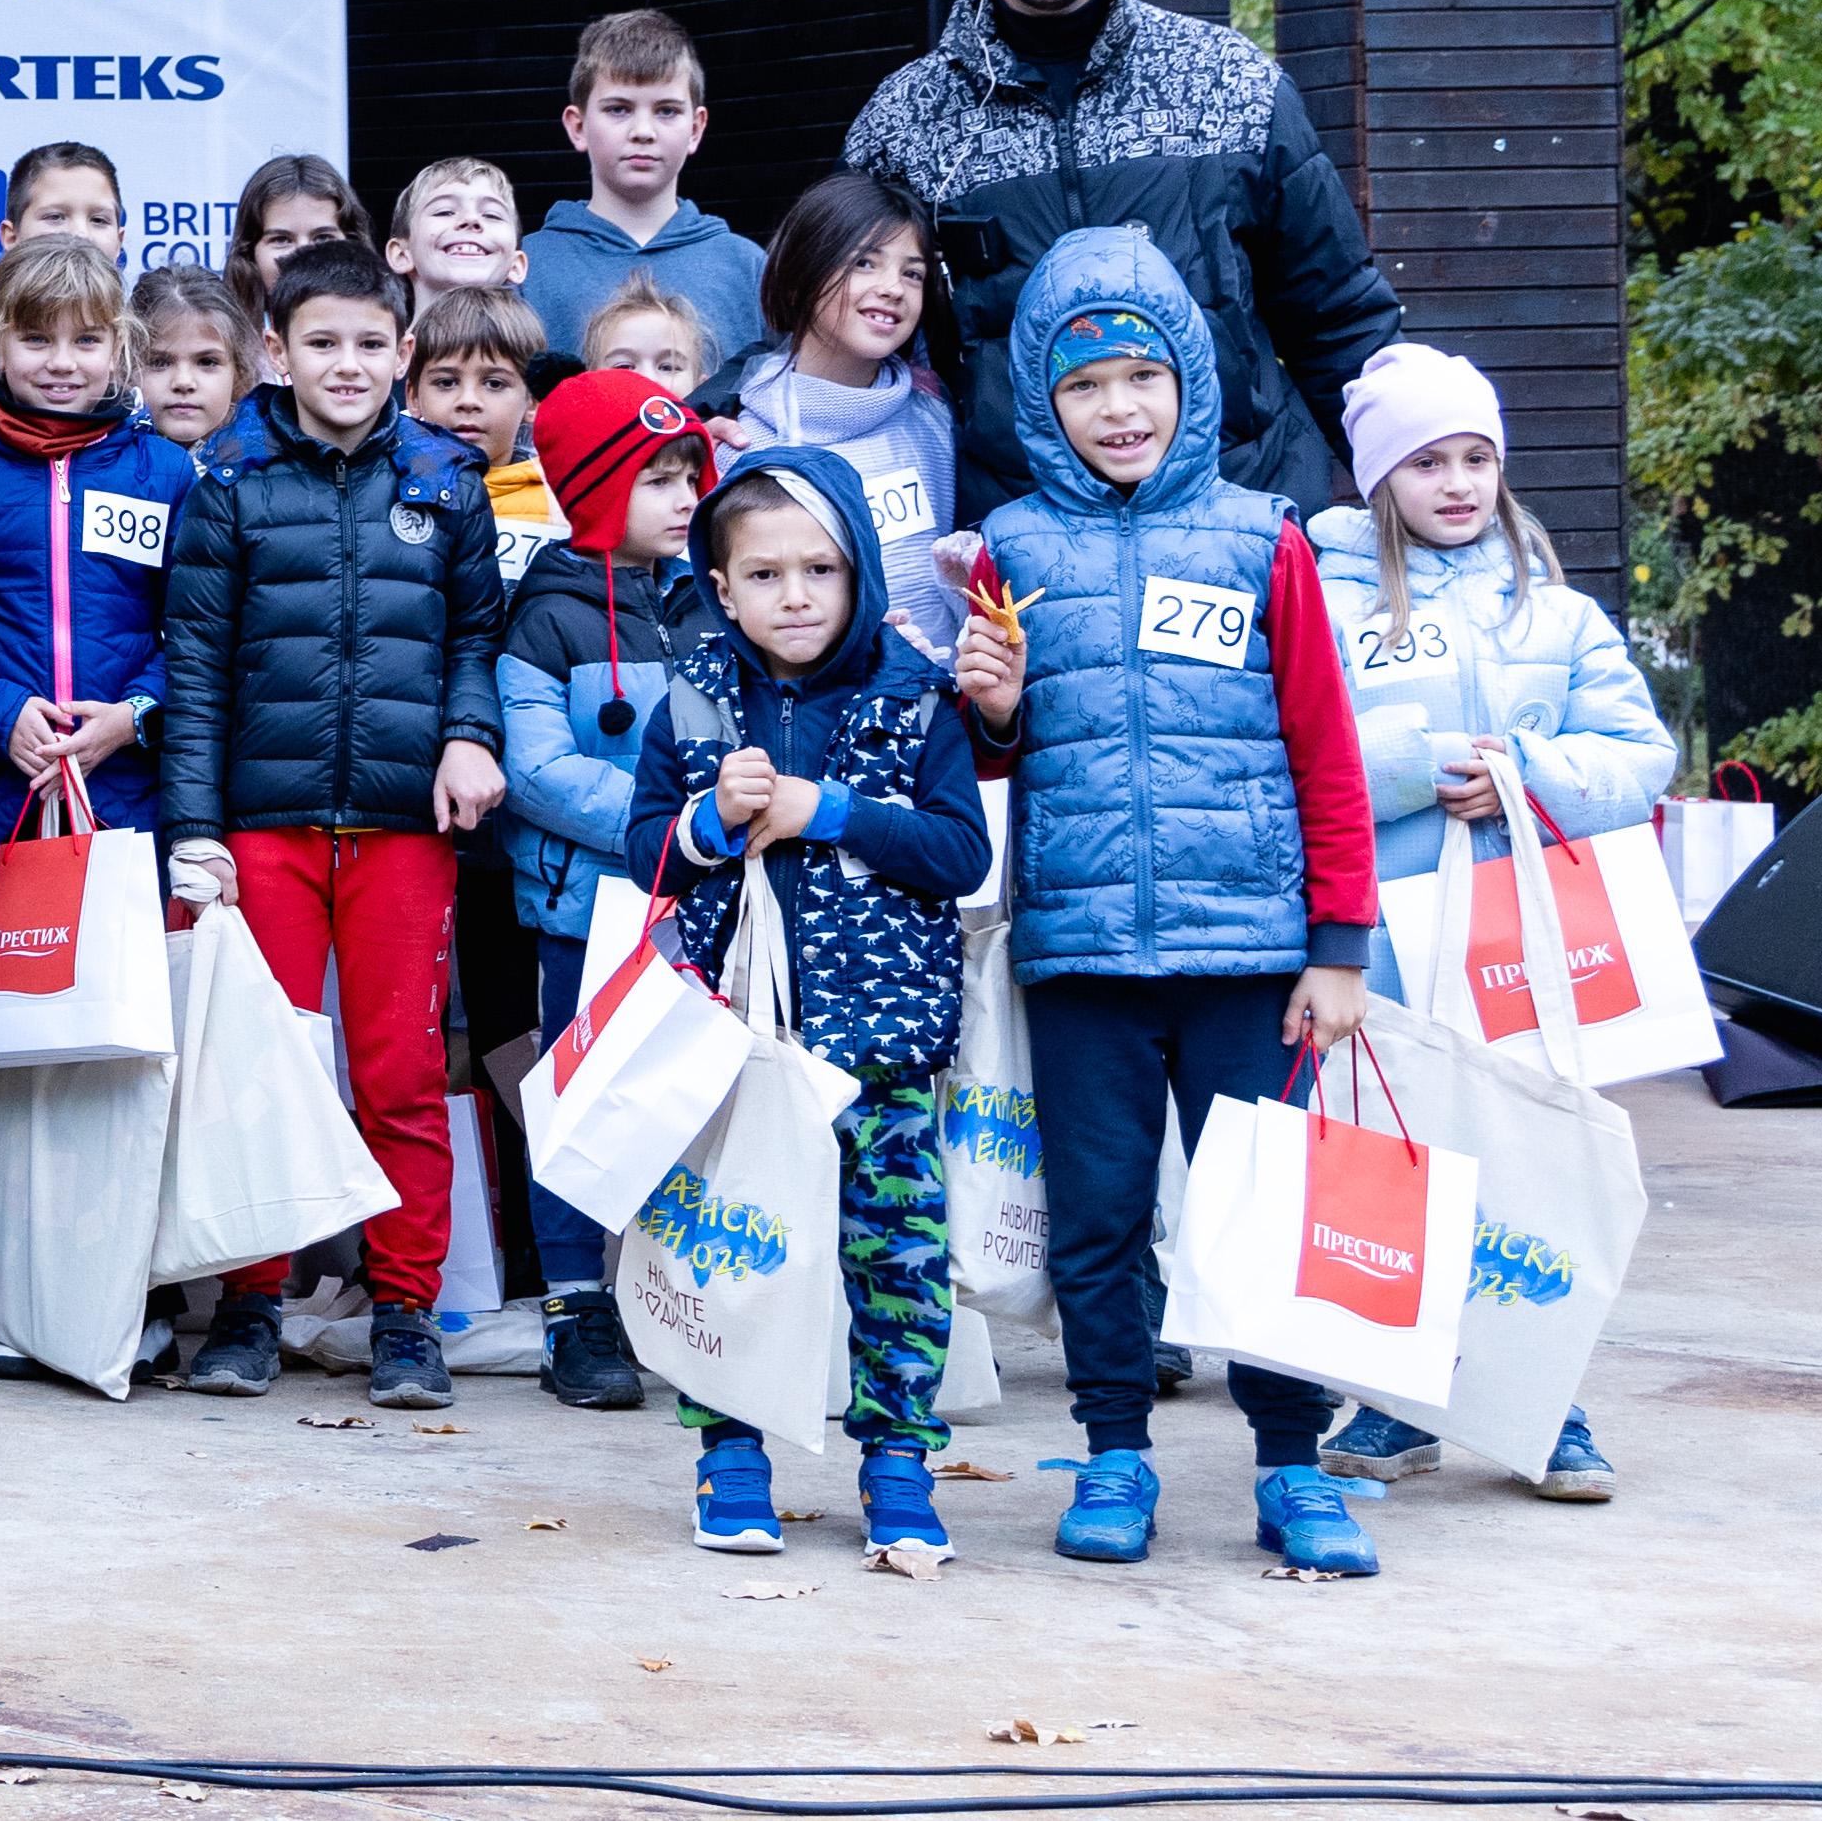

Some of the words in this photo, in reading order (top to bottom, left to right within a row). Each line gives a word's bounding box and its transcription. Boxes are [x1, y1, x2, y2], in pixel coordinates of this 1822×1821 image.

[143, 201, 239, 236] BRIT
[92, 504, 162, 551] 398
[496, 531, 542, 567] 27
[1152, 593, 1245, 647] 279
[1358, 622, 1449, 671] 293
[635, 1201, 688, 1252] СЕН
[690, 1242, 750, 1282] 025
[1311, 1222, 1416, 1275] ПРЕСТИЖ
